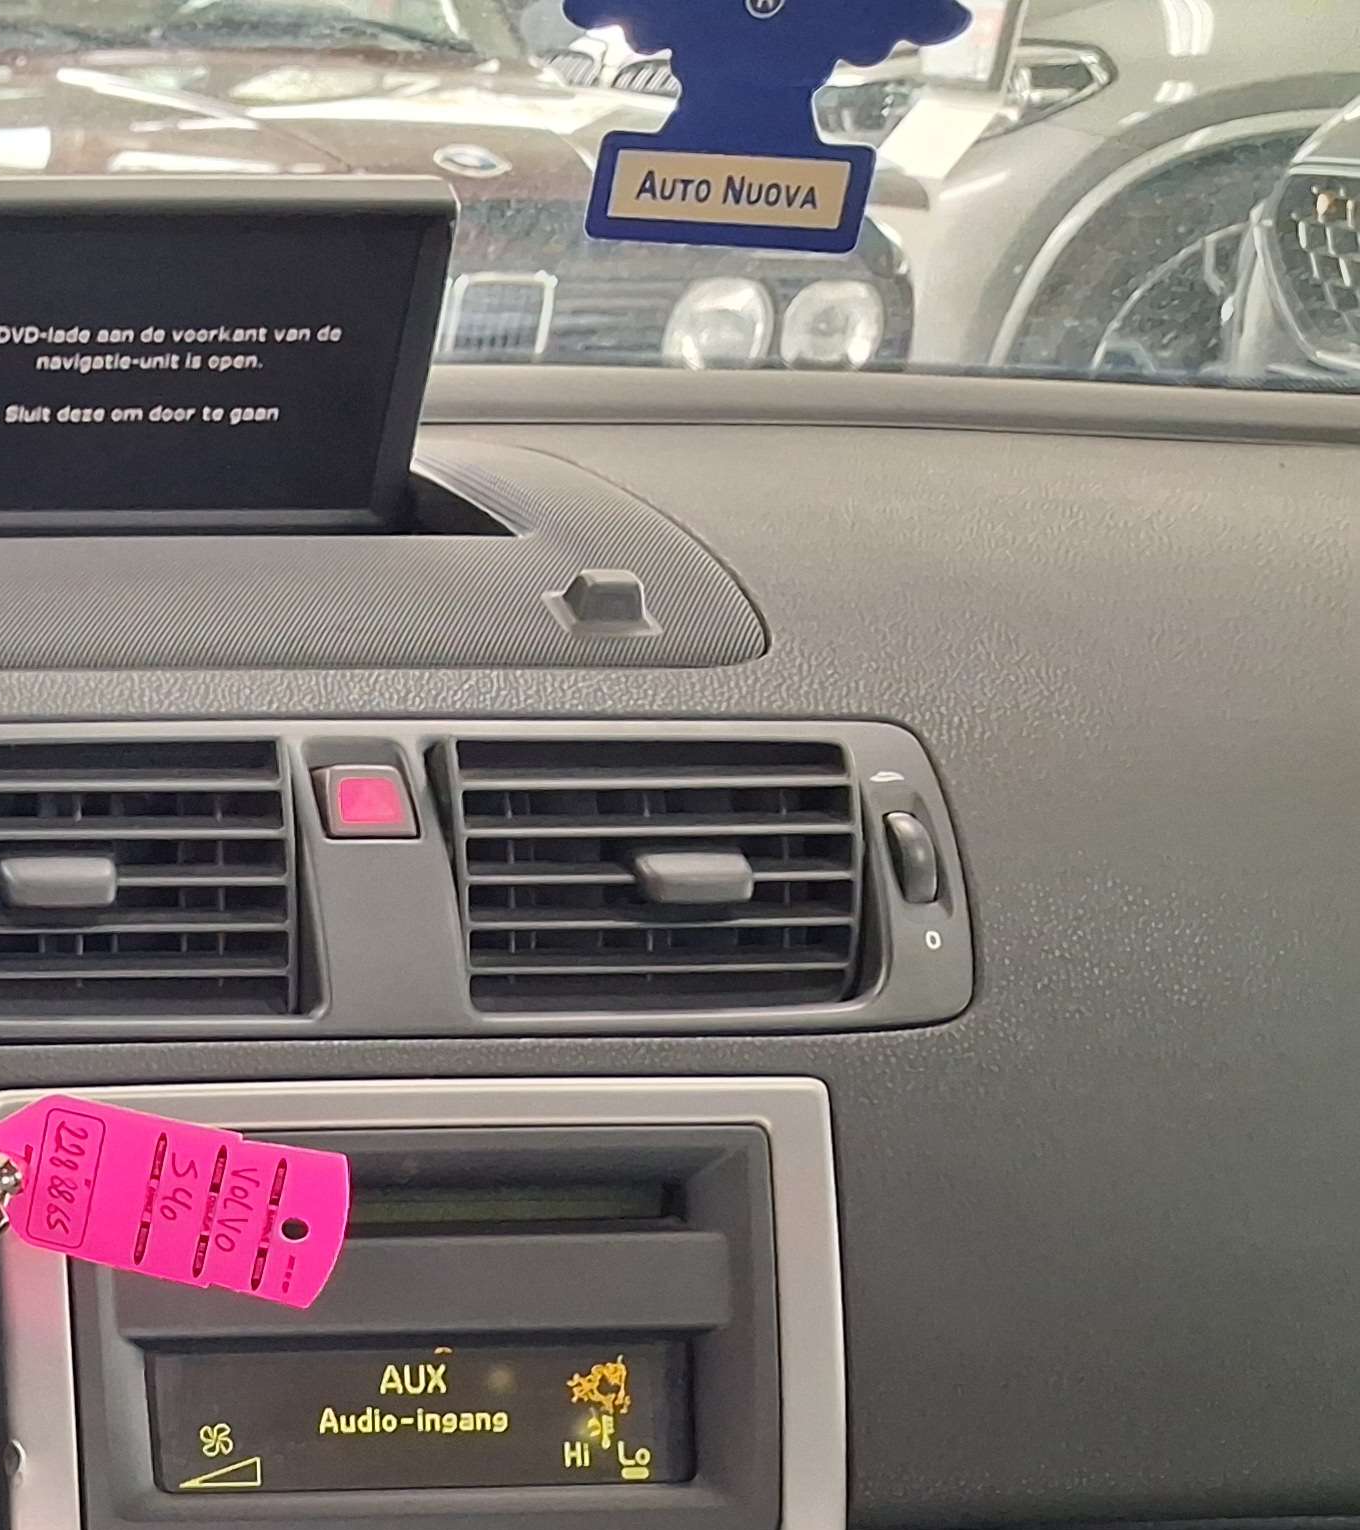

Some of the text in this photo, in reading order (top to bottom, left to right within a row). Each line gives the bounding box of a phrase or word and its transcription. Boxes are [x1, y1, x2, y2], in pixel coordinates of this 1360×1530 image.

[97, 328, 135, 344] aan
[140, 326, 166, 344] de
[172, 325, 267, 343] voorkant
[274, 327, 311, 343] van
[316, 325, 342, 342] de
[36, 352, 264, 374] navigatie-unit is open.
[4, 405, 279, 425] Sluit deze om door te gaan
[379, 1363, 448, 1395] AUX
[319, 1406, 509, 1434] Audio-ingang
[564, 1441, 590, 1467] Hi
[617, 1440, 651, 1466] Lo
